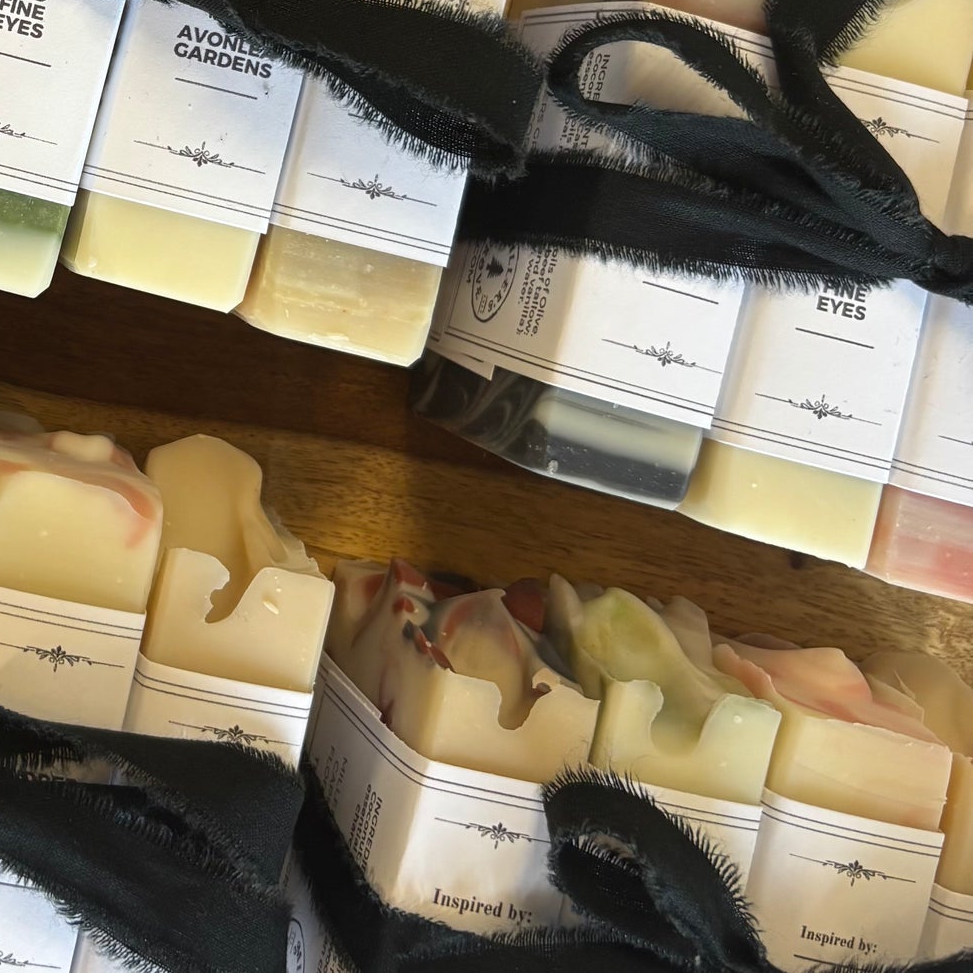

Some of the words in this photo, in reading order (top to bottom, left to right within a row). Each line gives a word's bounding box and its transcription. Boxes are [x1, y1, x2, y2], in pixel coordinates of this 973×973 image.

[173, 41, 273, 79] GARDENS
[816, 295, 867, 321] EYES
[432, 887, 503, 918] Inspired
[507, 903, 532, 926] by:
[800, 924, 855, 949] Inspired
[858, 938, 878, 955] by:
